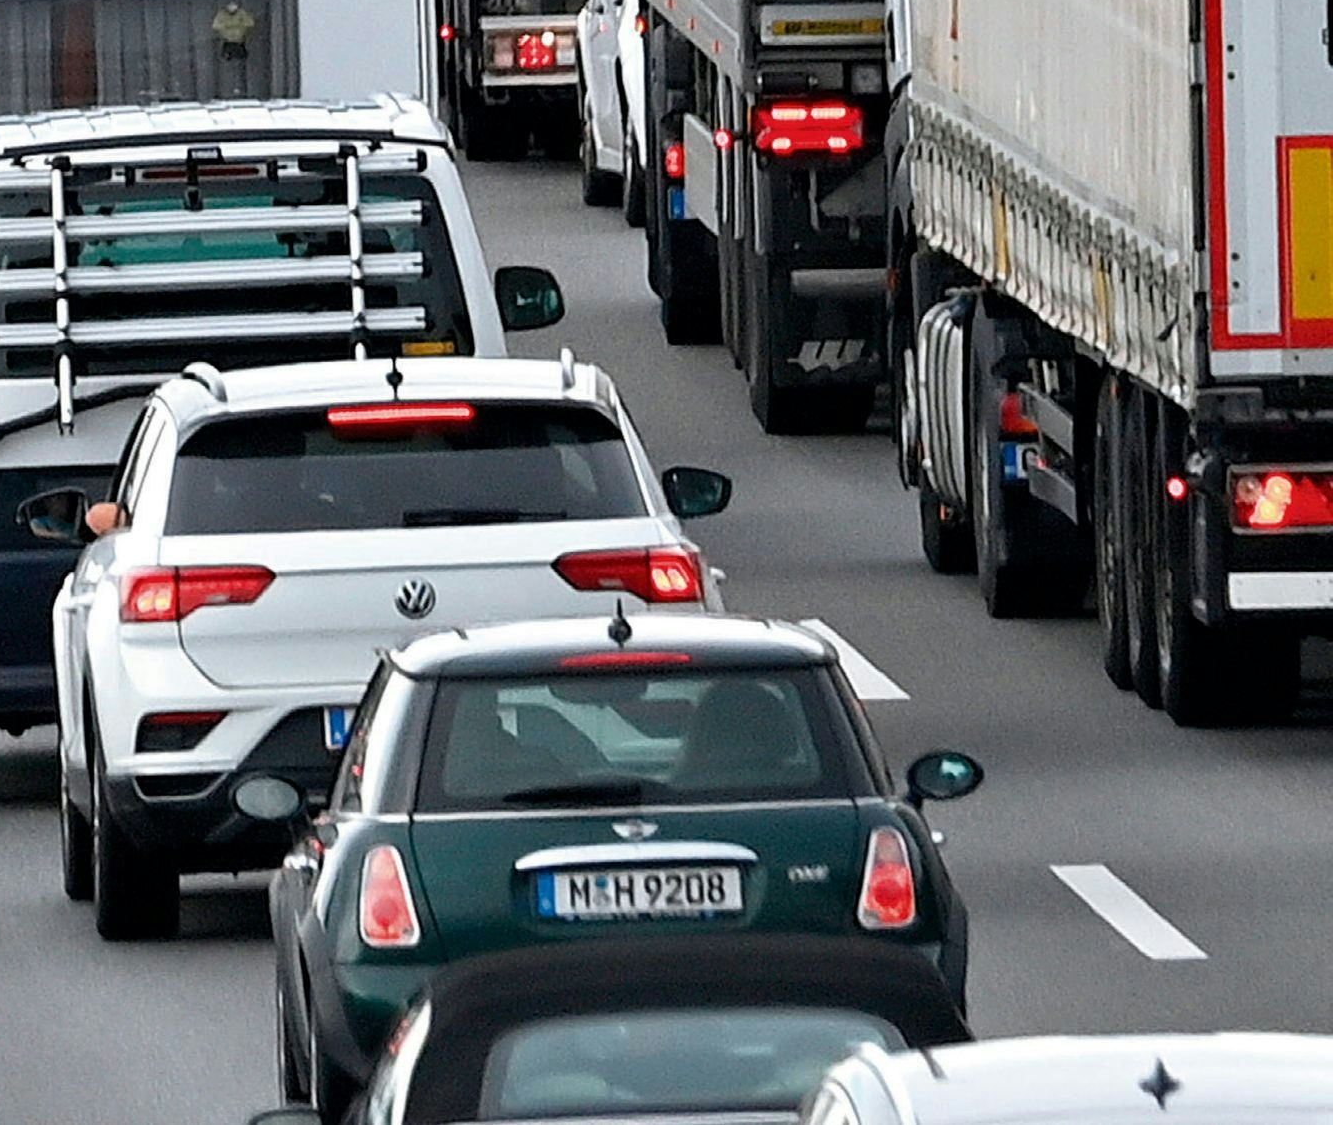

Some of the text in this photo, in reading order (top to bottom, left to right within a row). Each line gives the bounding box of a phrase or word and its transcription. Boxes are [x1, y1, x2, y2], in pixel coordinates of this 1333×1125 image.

[569, 872, 726, 909] M H 9208
